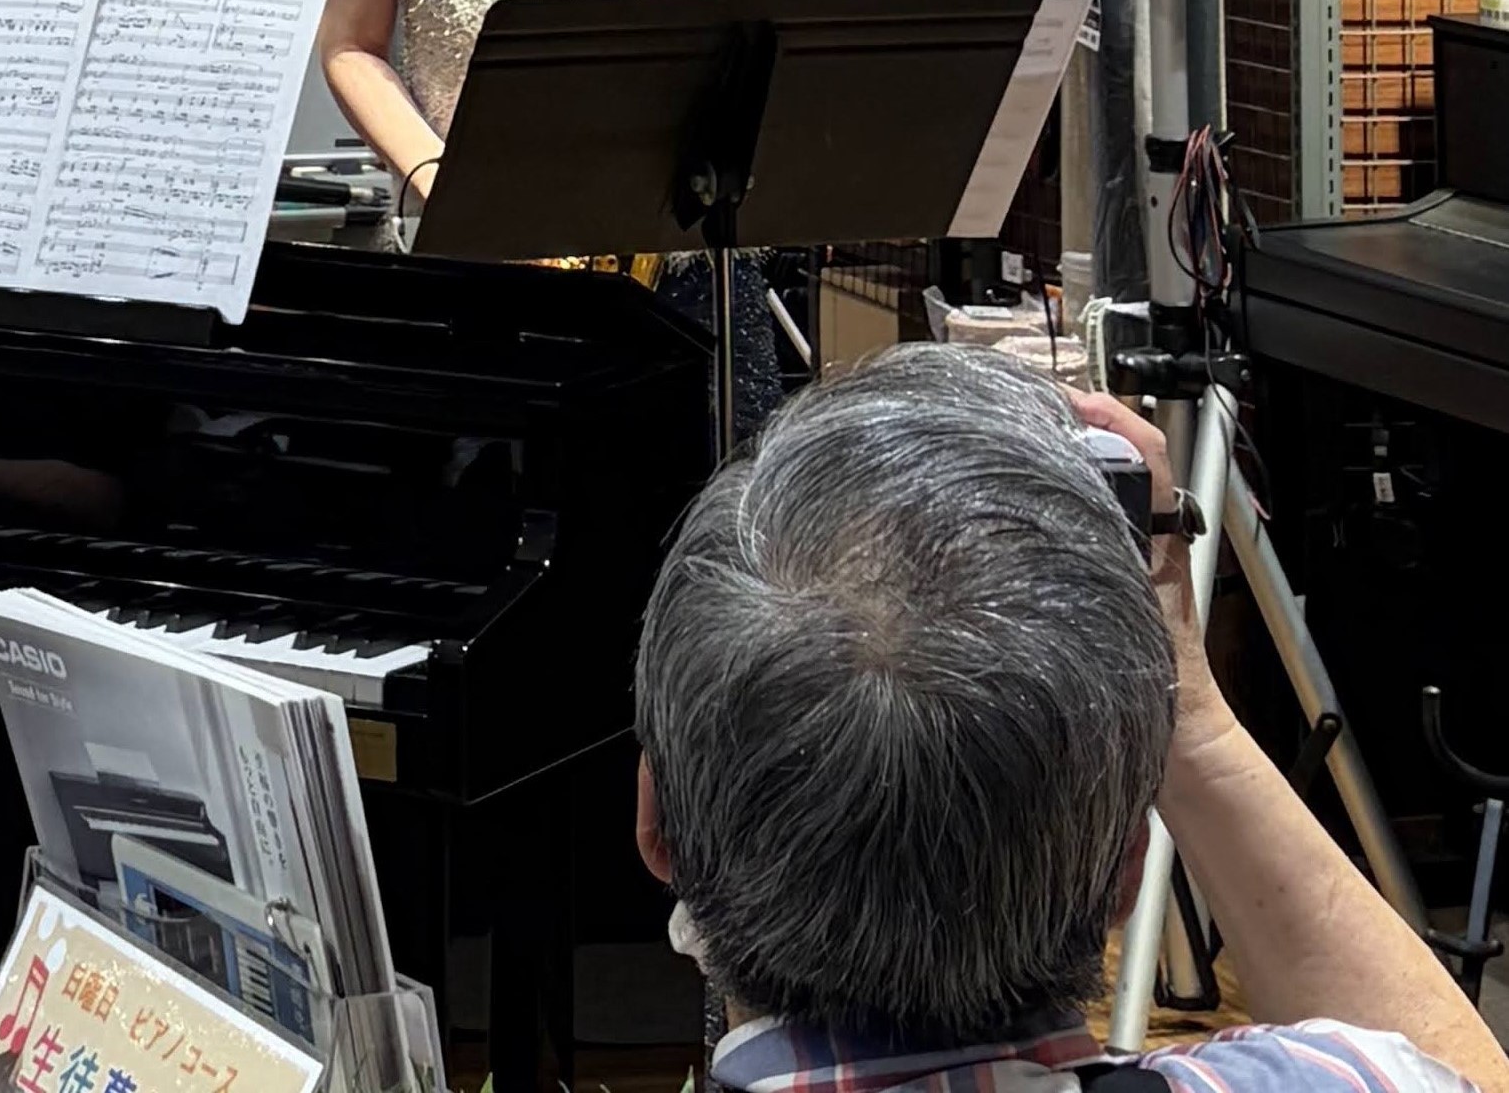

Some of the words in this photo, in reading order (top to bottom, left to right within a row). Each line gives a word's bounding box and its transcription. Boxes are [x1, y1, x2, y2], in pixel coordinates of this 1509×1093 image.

[62, 962, 120, 1023] 日曜日
[128, 1005, 239, 1093] ピアノコース
